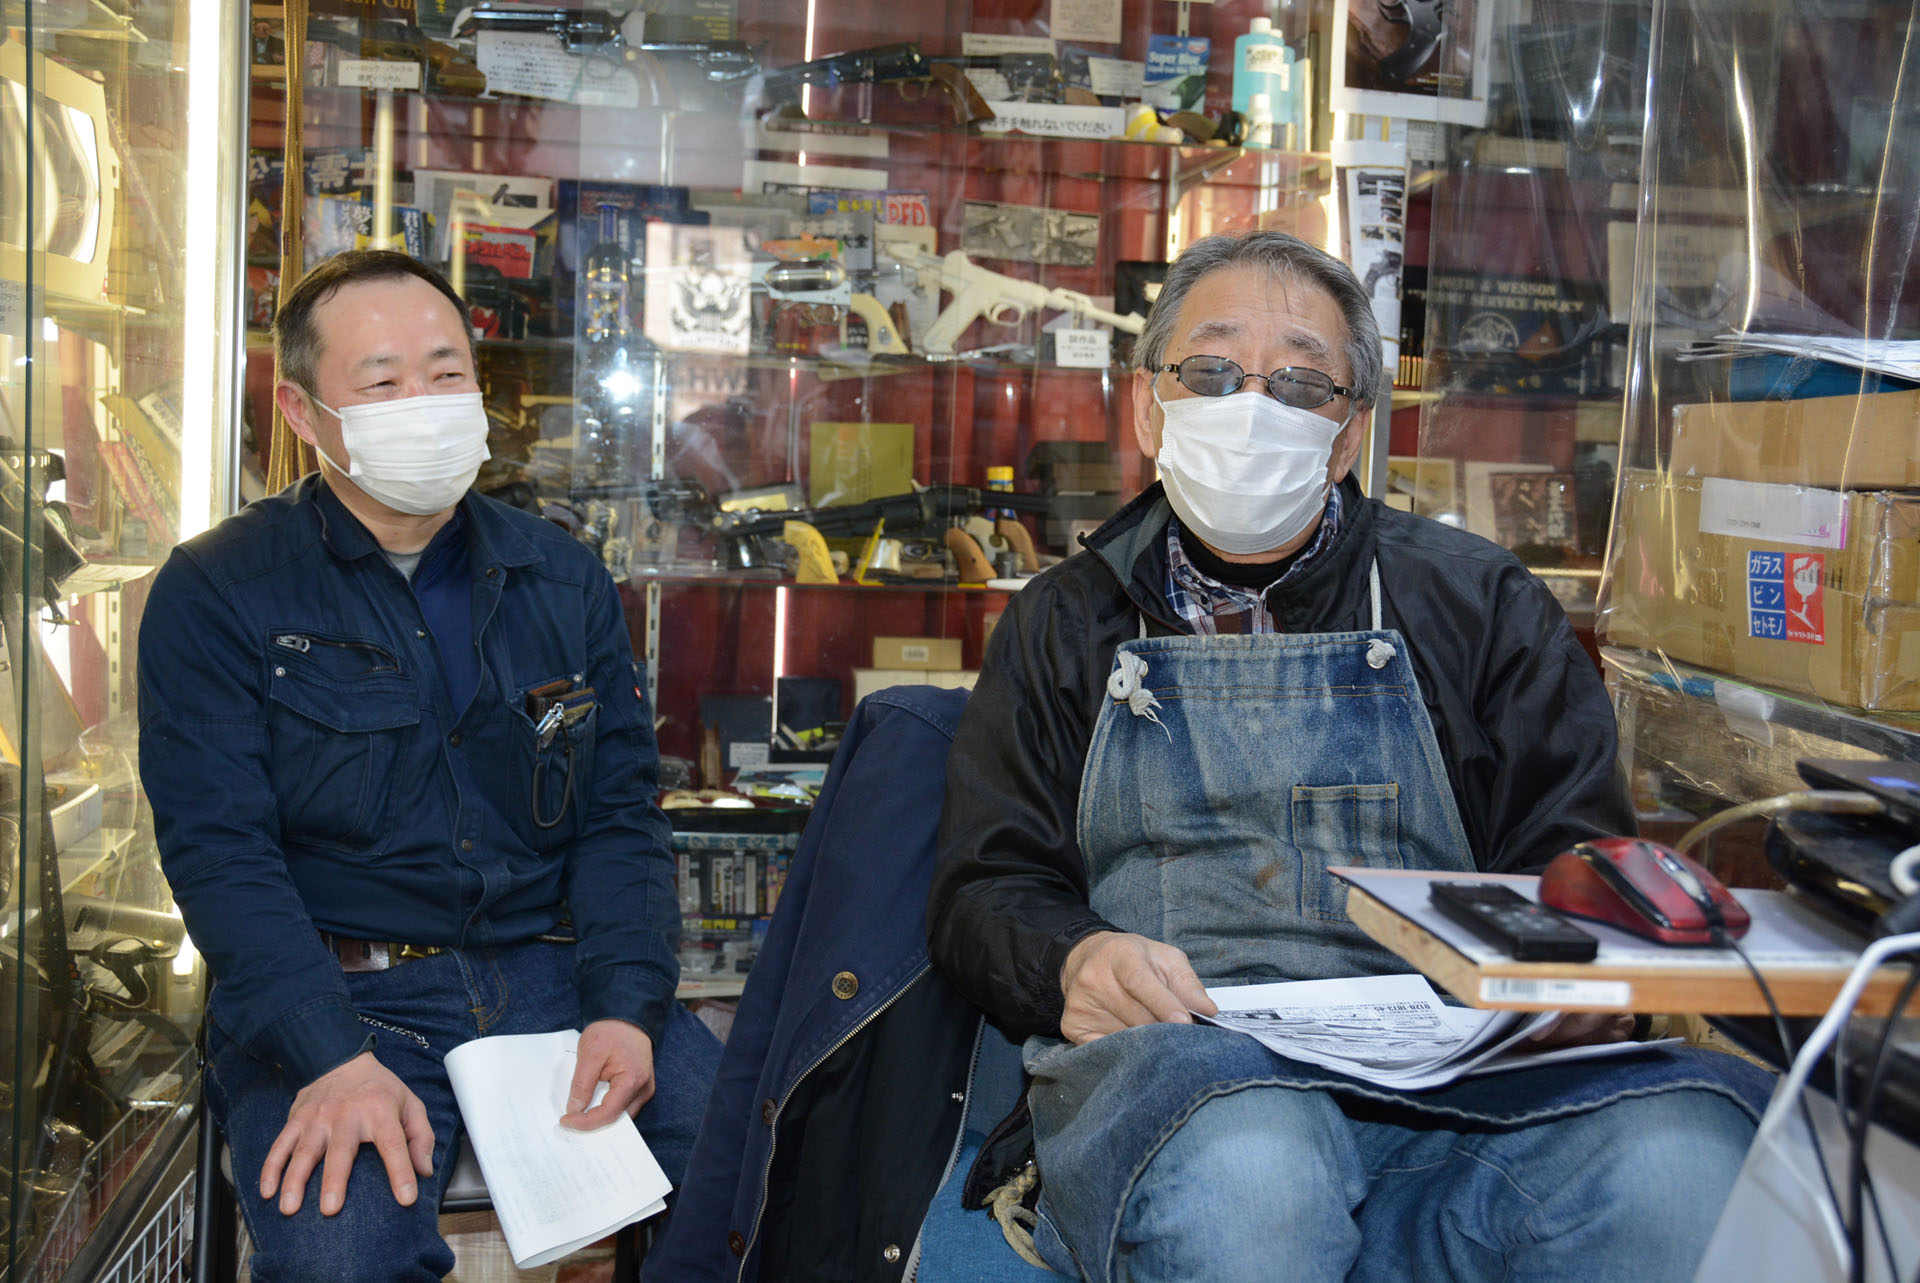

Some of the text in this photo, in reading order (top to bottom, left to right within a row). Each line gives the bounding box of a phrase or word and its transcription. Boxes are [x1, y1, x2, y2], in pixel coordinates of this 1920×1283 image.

[1497, 280, 1558, 297] WESSON
[1470, 293, 1529, 309] SERVICE
[1533, 298, 1586, 312] POLICY
[1751, 555, 1782, 575] ガラス
[1752, 617, 1783, 636] セトモノ
